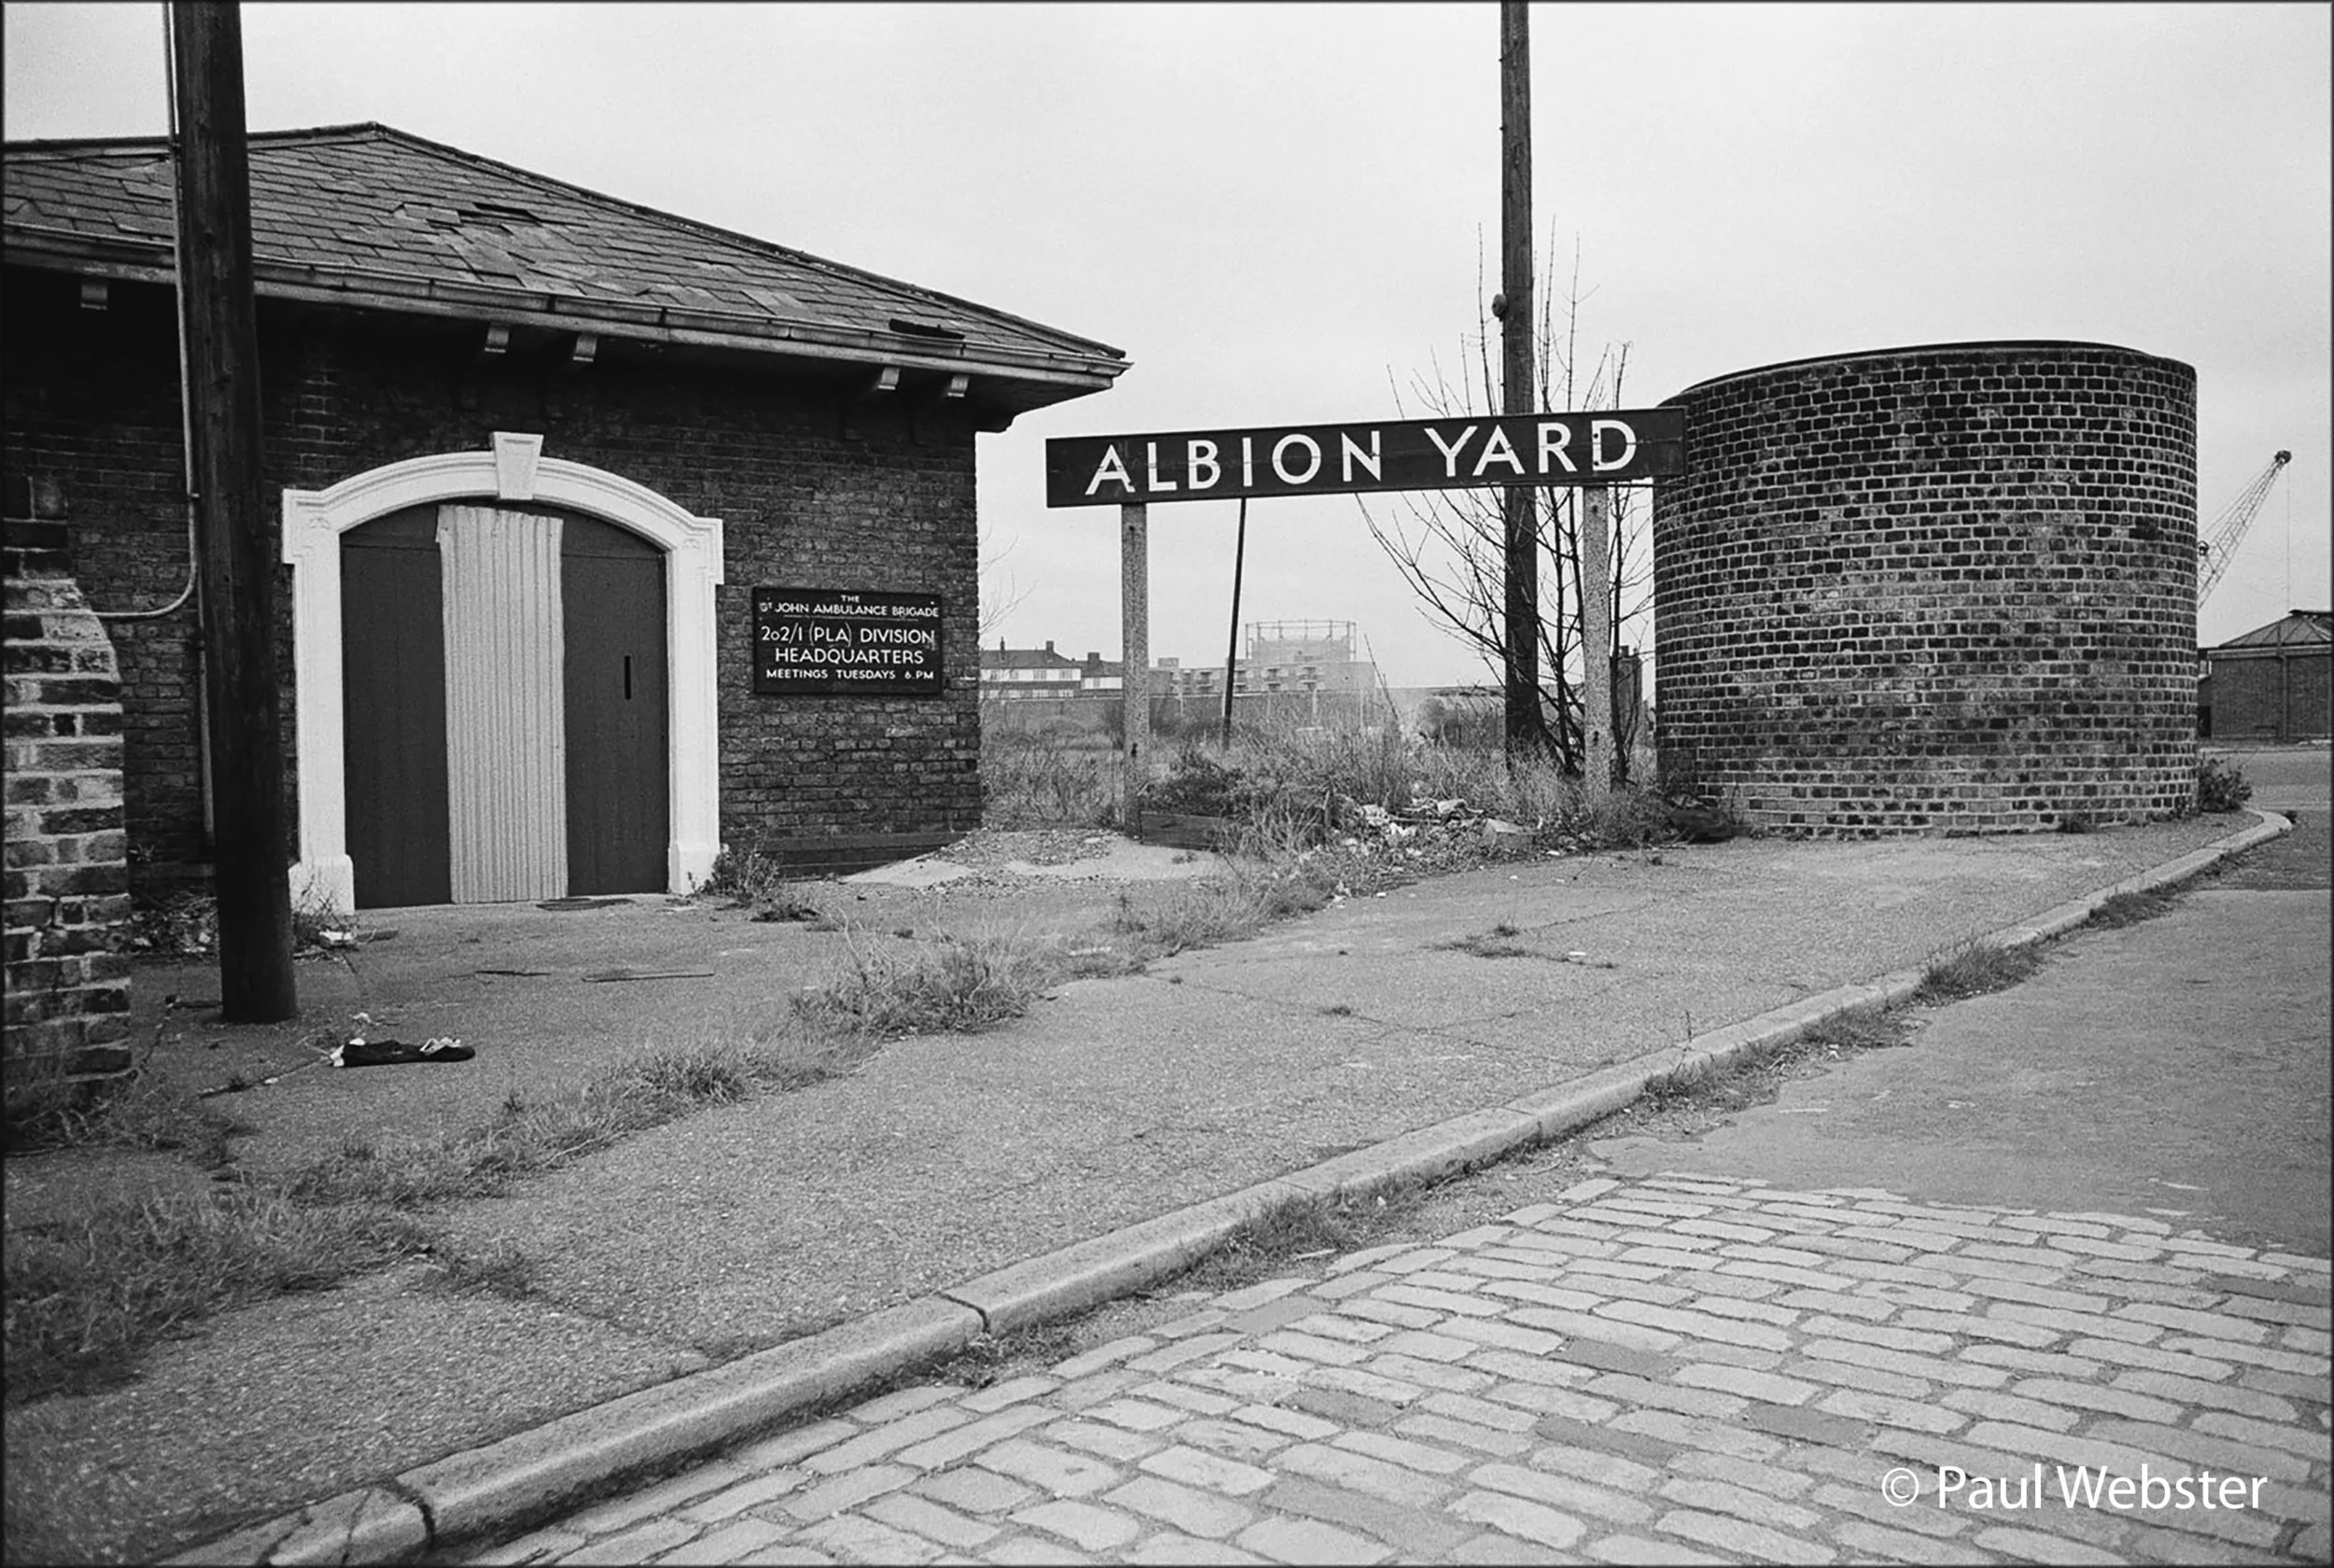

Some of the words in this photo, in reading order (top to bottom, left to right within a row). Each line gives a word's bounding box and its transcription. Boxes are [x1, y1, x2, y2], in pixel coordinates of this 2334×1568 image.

[1084, 430, 1382, 497] ALBION
[1423, 418, 1638, 478] YARD
[841, 595, 860, 603] THE
[775, 603, 809, 613] JOHN
[813, 604, 887, 616] AMBULANCE
[893, 607, 938, 618] BRIGADE
[809, 621, 851, 647] (PLA)
[860, 628, 935, 644] DIVISION
[775, 648, 924, 665] HEADQUARTERS
[766, 668, 828, 679] MEETINGS
[836, 669, 896, 679] TUESDAYS
